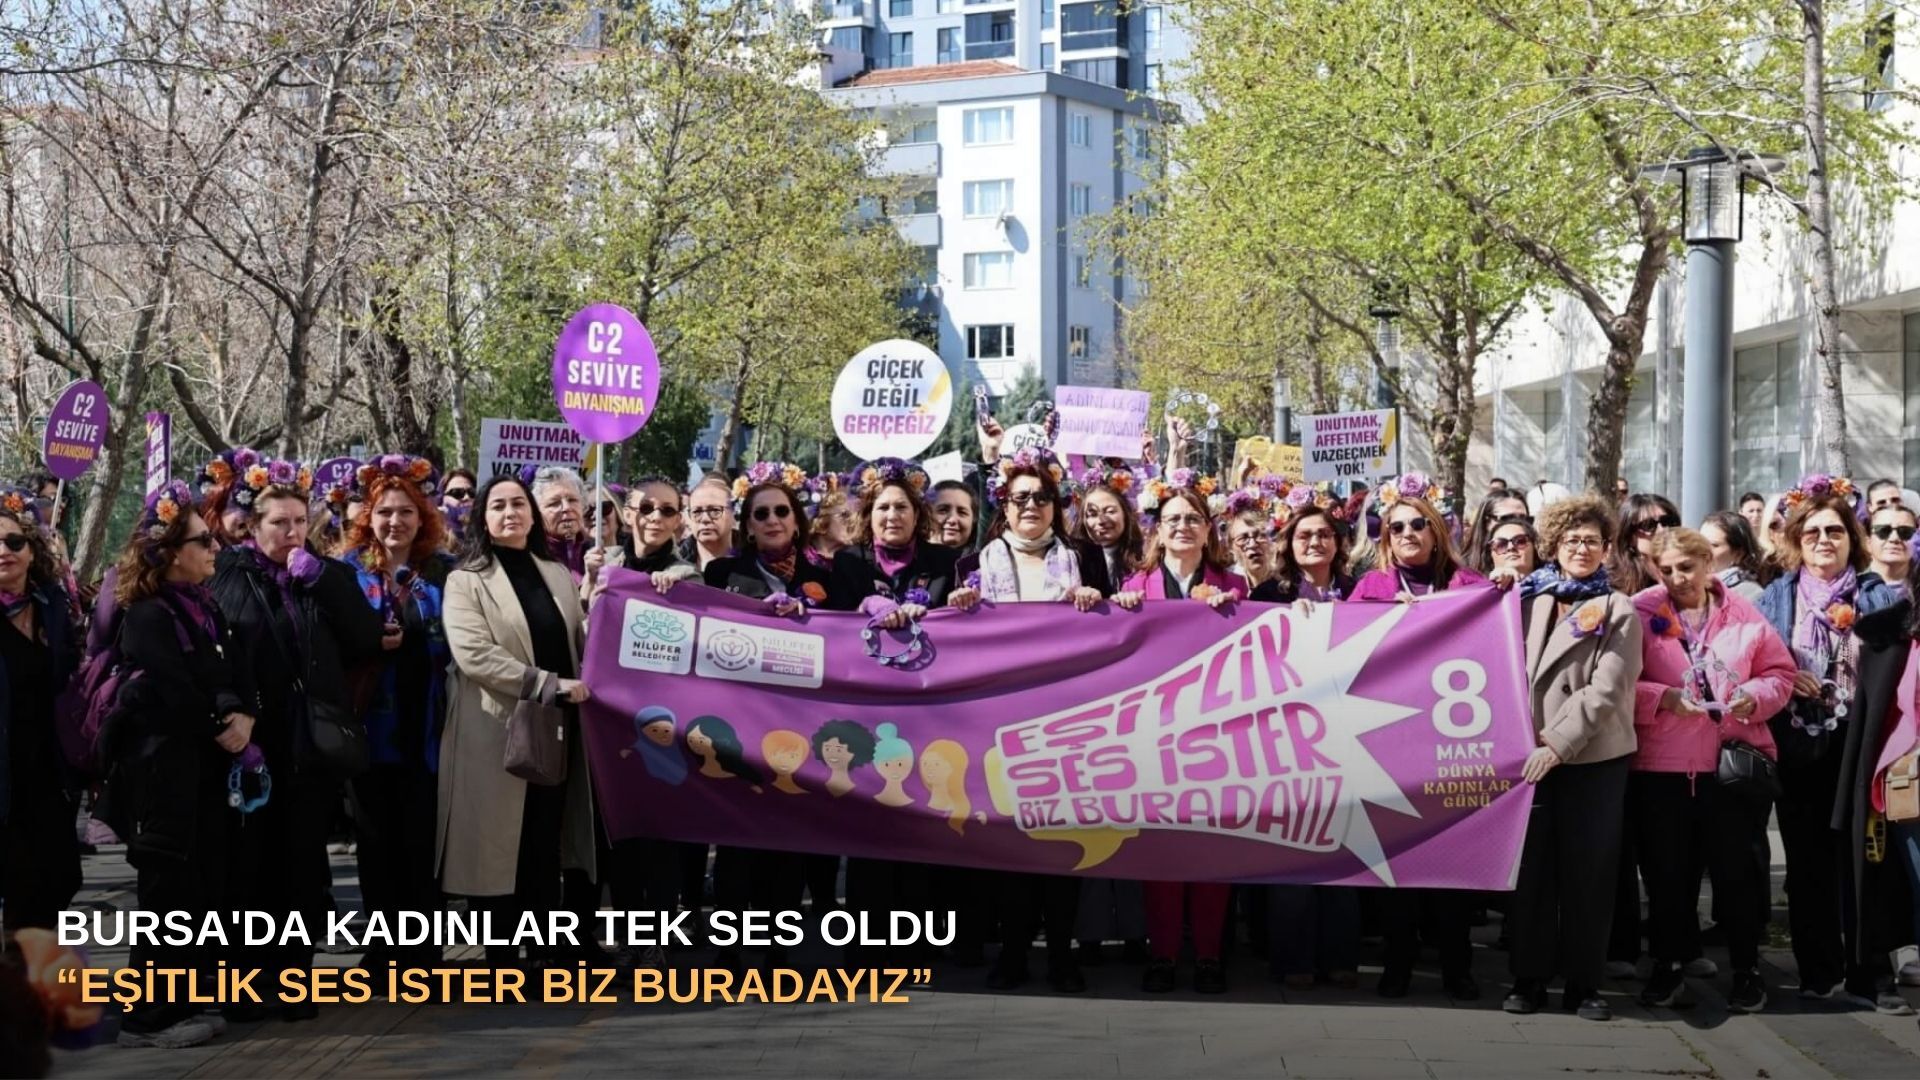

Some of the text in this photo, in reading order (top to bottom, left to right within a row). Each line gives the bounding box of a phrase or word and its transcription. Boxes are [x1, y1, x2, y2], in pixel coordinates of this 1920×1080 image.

[587, 321, 623, 355] C2
[567, 357, 643, 390] SEVİYE
[867, 354, 925, 384] ÇİÇEK
[72, 393, 95, 418] C2
[563, 390, 645, 418] DAYANIŞMA
[862, 383, 922, 408] DEĞİL
[55, 418, 99, 442] SEVİYE
[843, 410, 937, 440] GERÇEĞİZ
[1315, 414, 1382, 432] UNUTMAK,
[499, 424, 586, 446] UNUTMAK,
[1315, 430, 1382, 447] AFFETMEK,
[48, 441, 95, 462] DAYANIŞMA
[497, 443, 584, 464] AFFETMEK,
[1312, 445, 1387, 463] VAZGEÇMEK
[331, 462, 353, 479] C2
[1335, 463, 1365, 476] YOK!
[633, 640, 682, 654] NİLÜFER
[1001, 613, 1302, 758] EŞİTLİK
[1431, 658, 1492, 739] 8
[1006, 702, 1341, 798] SES İSTER
[1436, 742, 1495, 761] MART
[1438, 763, 1495, 778] DÜNYA
[1424, 780, 1512, 795] KADINLAR
[1018, 775, 1343, 846] BİZ BURADAYIZ
[1443, 793, 1491, 808] GÜNÜ
